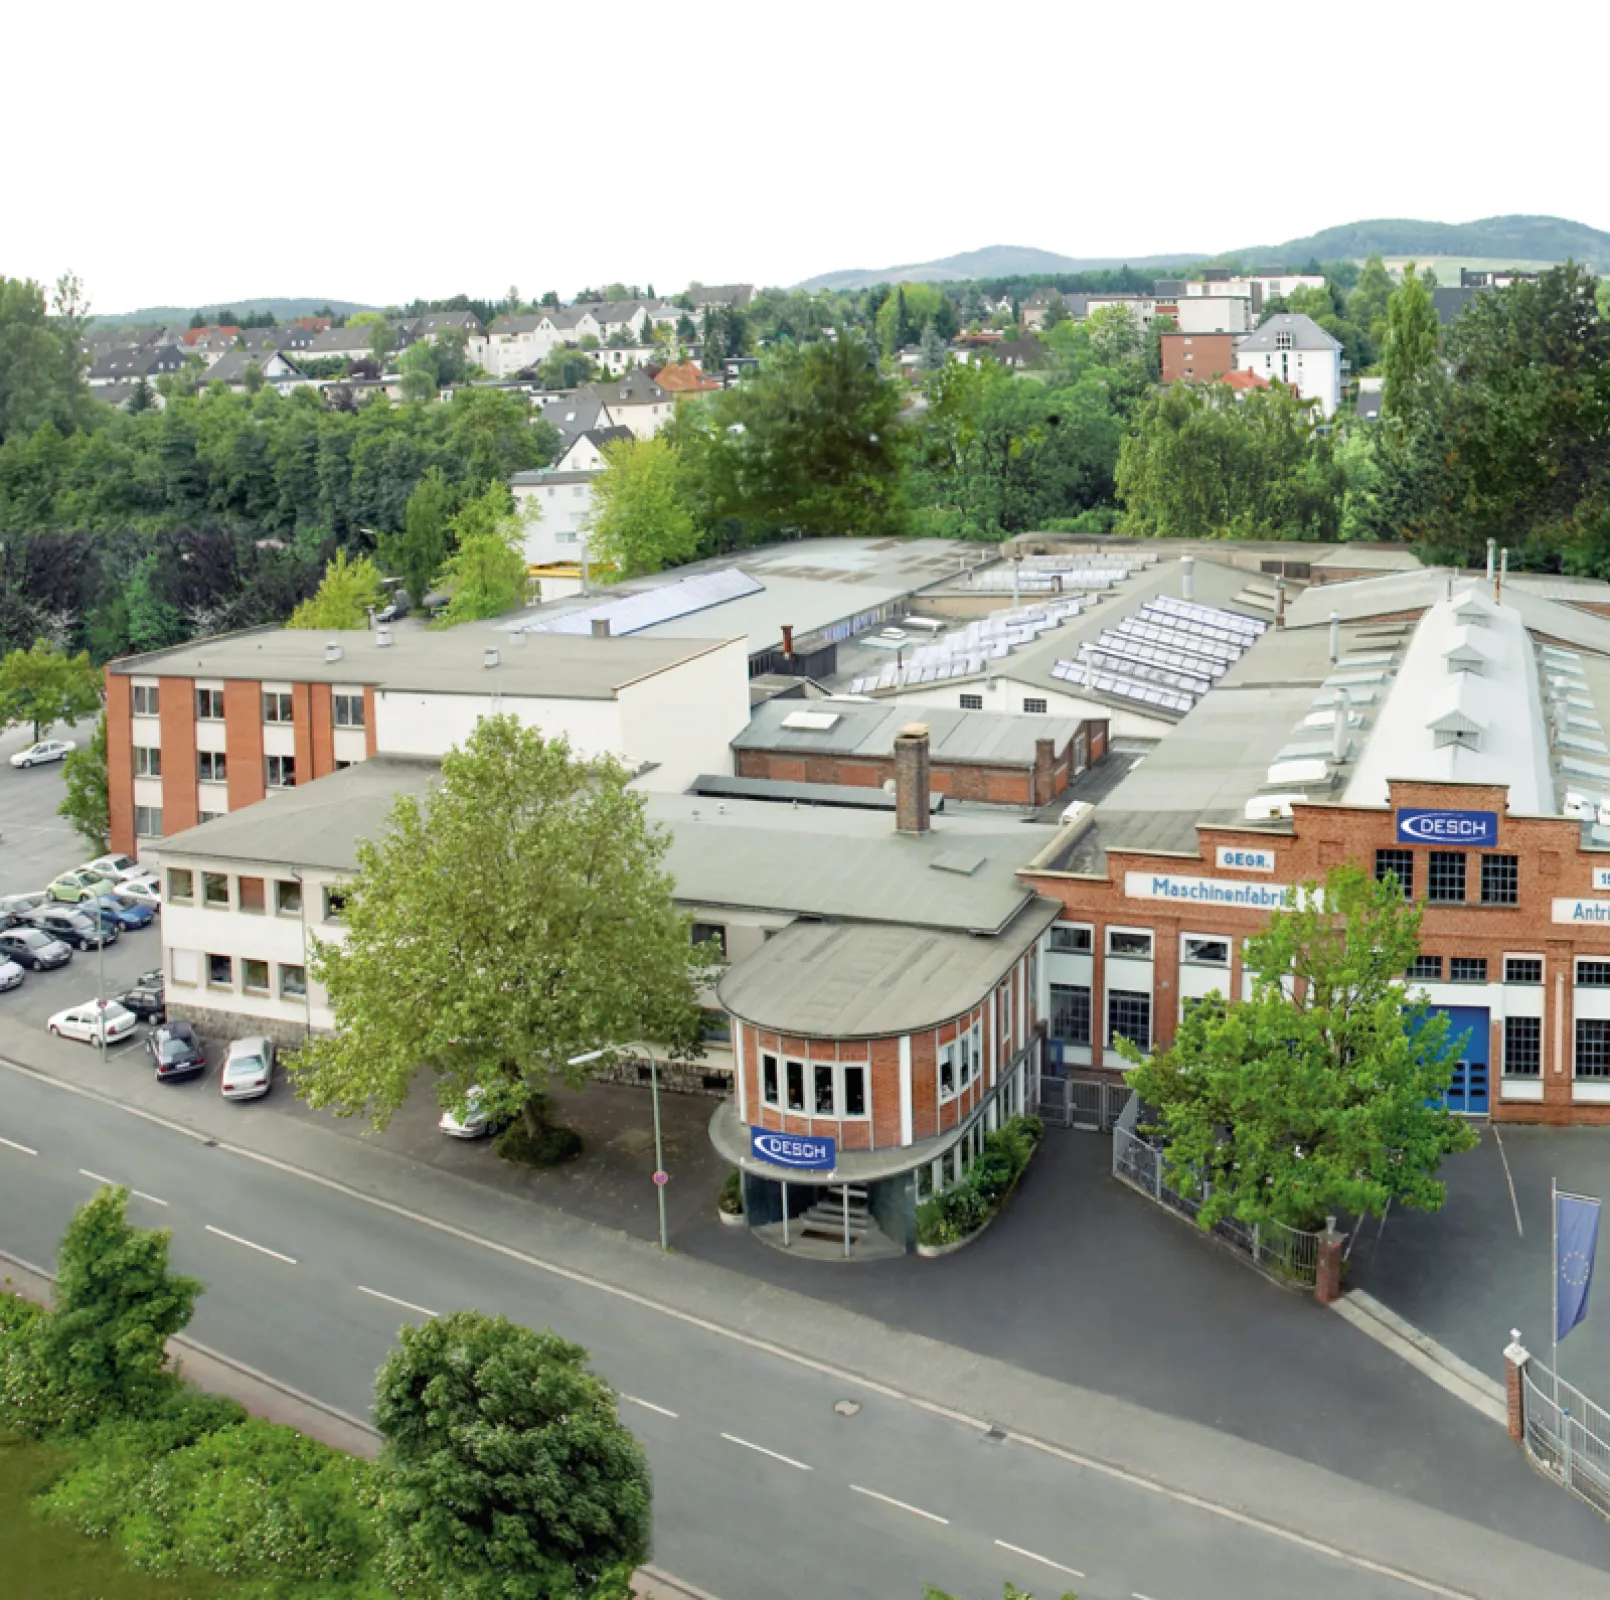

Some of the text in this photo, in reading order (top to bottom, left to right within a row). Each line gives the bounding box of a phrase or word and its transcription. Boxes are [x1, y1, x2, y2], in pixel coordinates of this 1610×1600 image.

[1420, 818, 1486, 835] DESCH
[1223, 852, 1270, 868] GEGR.
[1152, 876, 1296, 908] Maschinenfabri
[770, 1138, 826, 1158] DESCH
